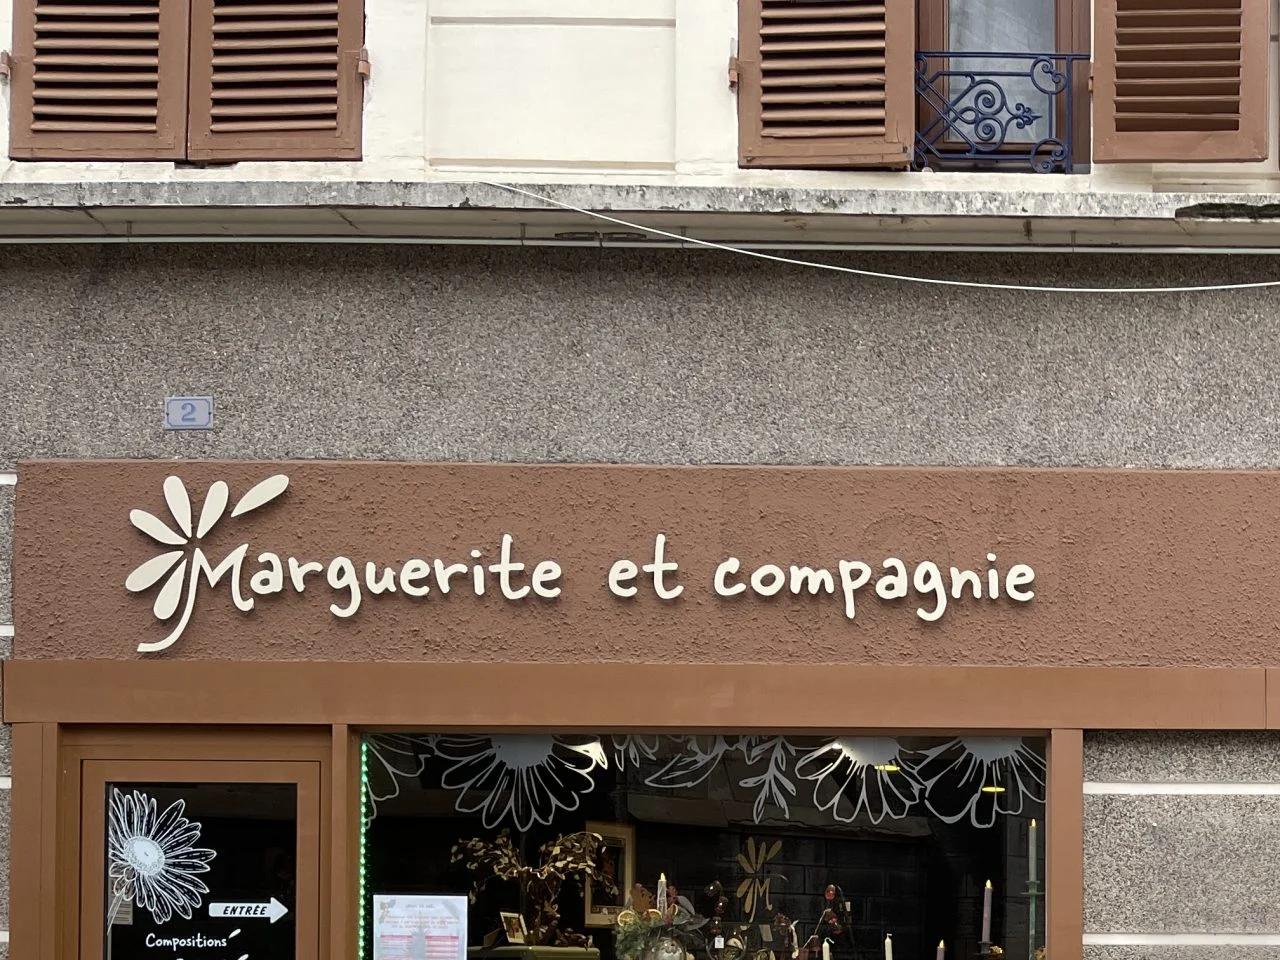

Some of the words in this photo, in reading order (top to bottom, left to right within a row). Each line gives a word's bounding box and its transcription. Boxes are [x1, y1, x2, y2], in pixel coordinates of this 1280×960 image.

[181, 402, 197, 422] 2
[137, 533, 562, 652] Marguerite
[608, 533, 684, 599] et
[715, 551, 1036, 622] compagnie
[145, 933, 227, 951] Compositions
